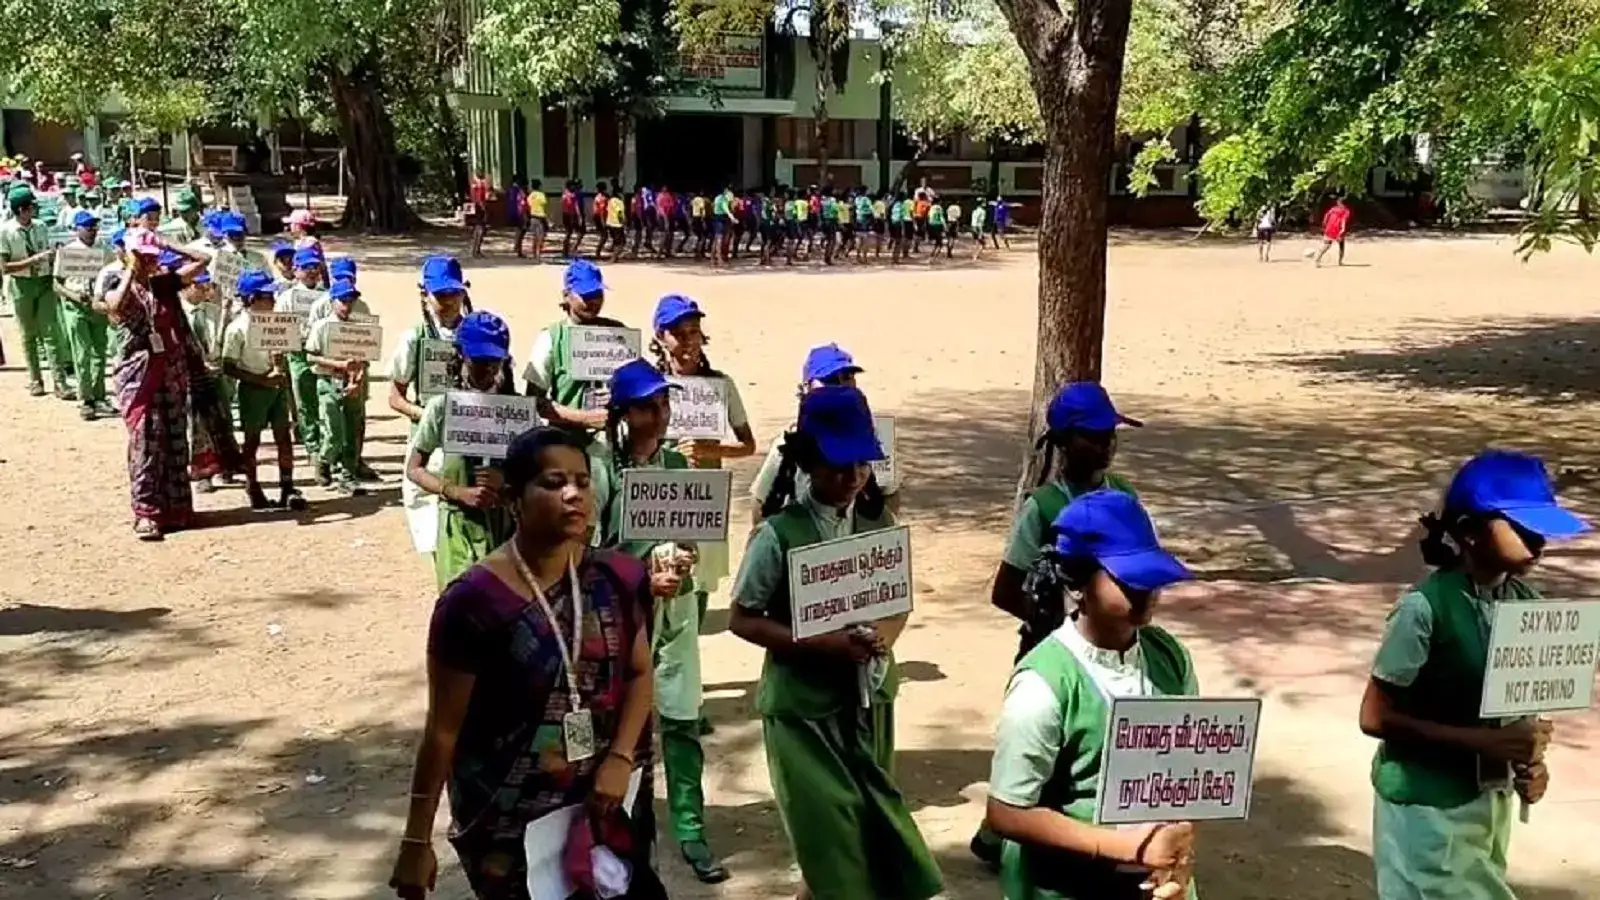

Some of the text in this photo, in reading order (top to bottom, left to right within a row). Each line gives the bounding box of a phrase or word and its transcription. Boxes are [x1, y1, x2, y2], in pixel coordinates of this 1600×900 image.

[631, 482, 713, 501] DRUGS KILL
[630, 510, 723, 528] YOUR FUTURE
[800, 541, 904, 586] போதையை ஒழிக்கும்
[800, 576, 908, 622] பாதையை வளர்ப்போம்
[1520, 609, 1581, 634] SAY NO TO
[1538, 644, 1565, 668] LIFE
[1565, 642, 1594, 666] DOES
[1504, 677, 1576, 704] NOT REWIND
[1116, 717, 1171, 756] போதை
[1117, 768, 1236, 810] நாட்டுக்கும் கேடு
